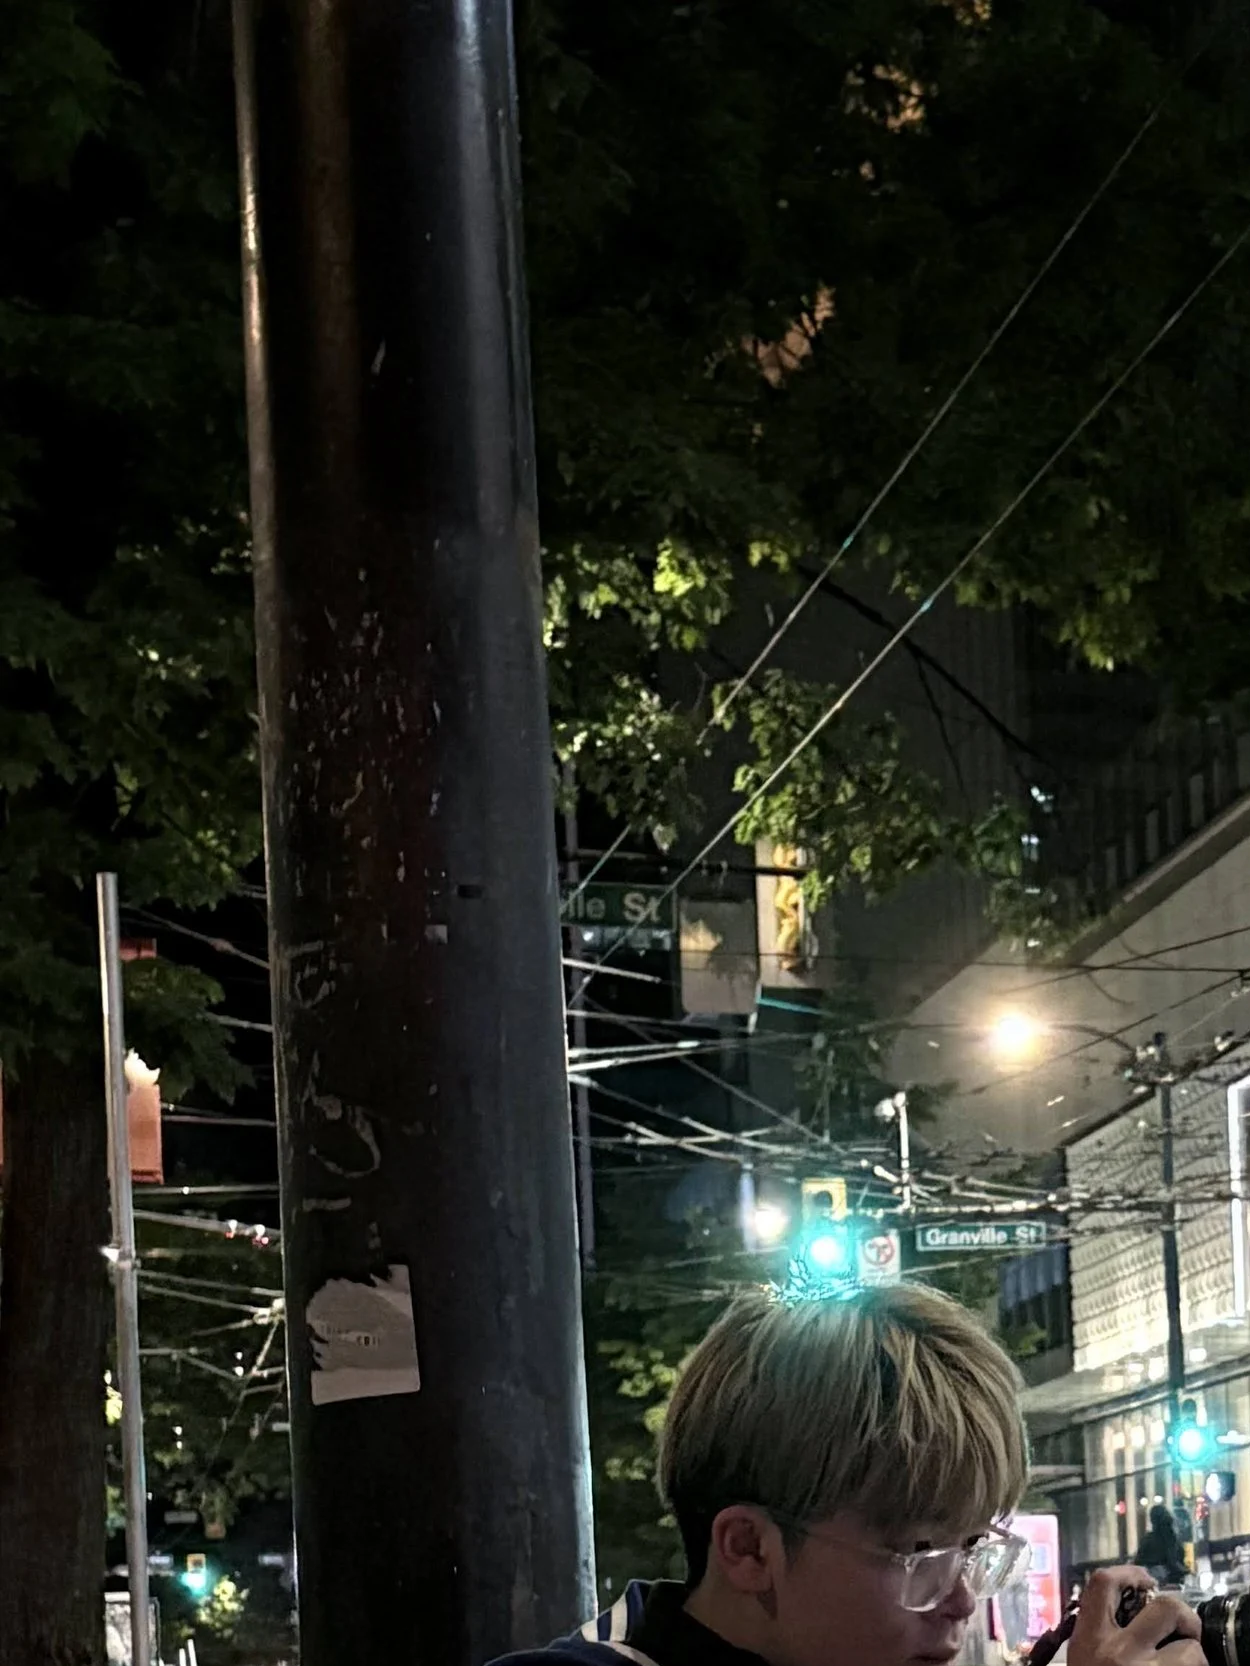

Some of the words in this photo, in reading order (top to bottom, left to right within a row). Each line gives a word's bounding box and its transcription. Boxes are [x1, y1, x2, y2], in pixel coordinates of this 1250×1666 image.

[623, 892, 661, 922] St
[925, 1226, 1008, 1246] Granville
[1014, 1225, 1037, 1245] St
